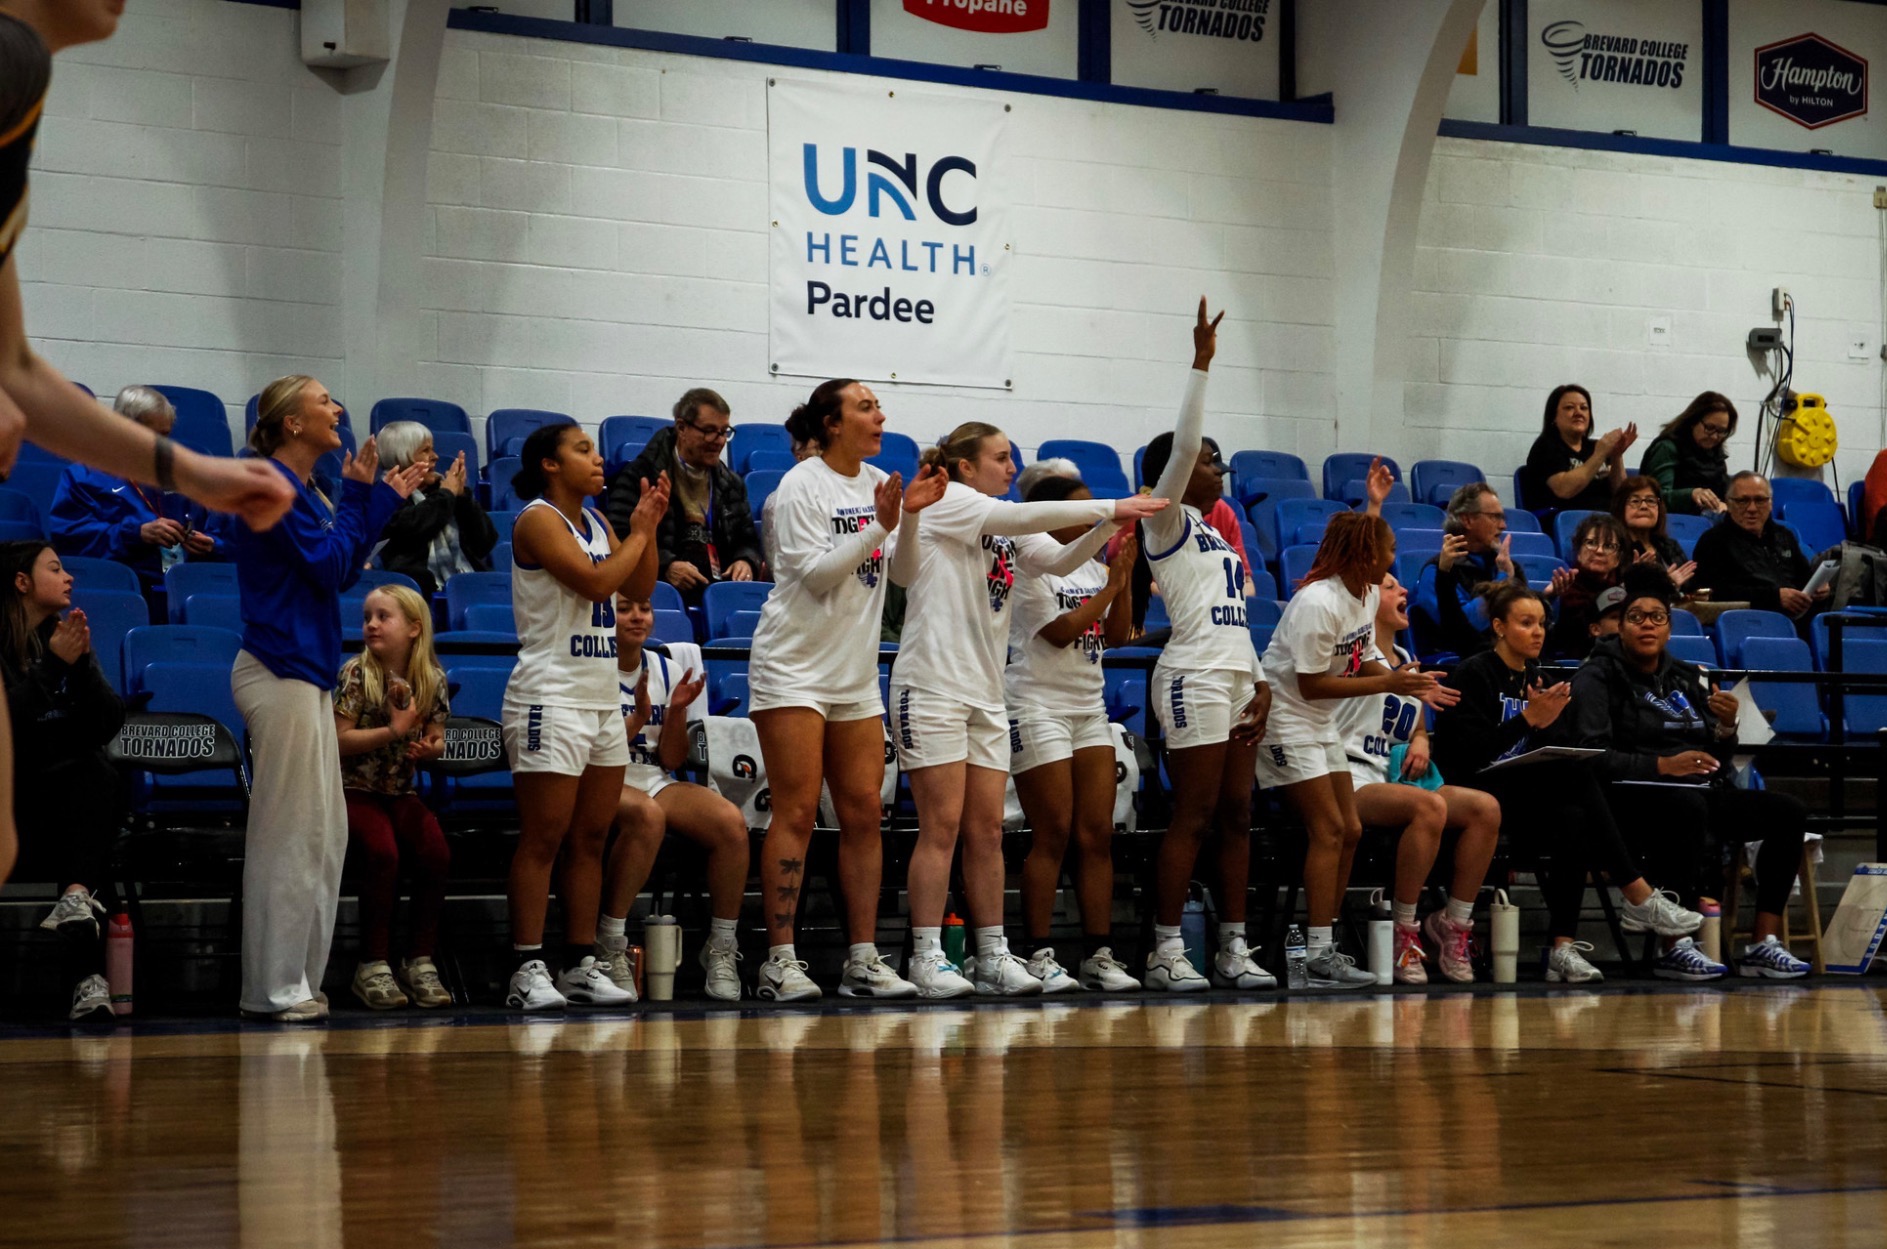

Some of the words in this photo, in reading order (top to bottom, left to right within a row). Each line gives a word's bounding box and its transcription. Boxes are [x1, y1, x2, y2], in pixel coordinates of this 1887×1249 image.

[925, 0, 1027, 16] opane
[1158, 4, 1266, 42] TORNADOS
[1583, 33, 1638, 54] BREVARD
[1639, 39, 1688, 60] COLLEGE
[1579, 53, 1685, 88] TORNADOS
[1760, 57, 1862, 95] Hampton
[1789, 95, 1800, 106] by
[1802, 96, 1834, 107] HILTON
[803, 142, 978, 226] UNC
[807, 231, 976, 276] HEALTH
[807, 280, 935, 324] Pardee
[1223, 557, 1245, 601] 14
[570, 634, 617, 658] COLLE
[121, 724, 170, 737] BREVARD
[170, 724, 216, 737] COLLEGE
[460, 728, 501, 740] COLLEGE
[528, 704, 543, 751] RNADOS
[900, 689, 914, 749] TORNADOS
[1381, 694, 1417, 741] 20
[120, 736, 215, 758] TORNADOS
[438, 740, 500, 760] NADOS
